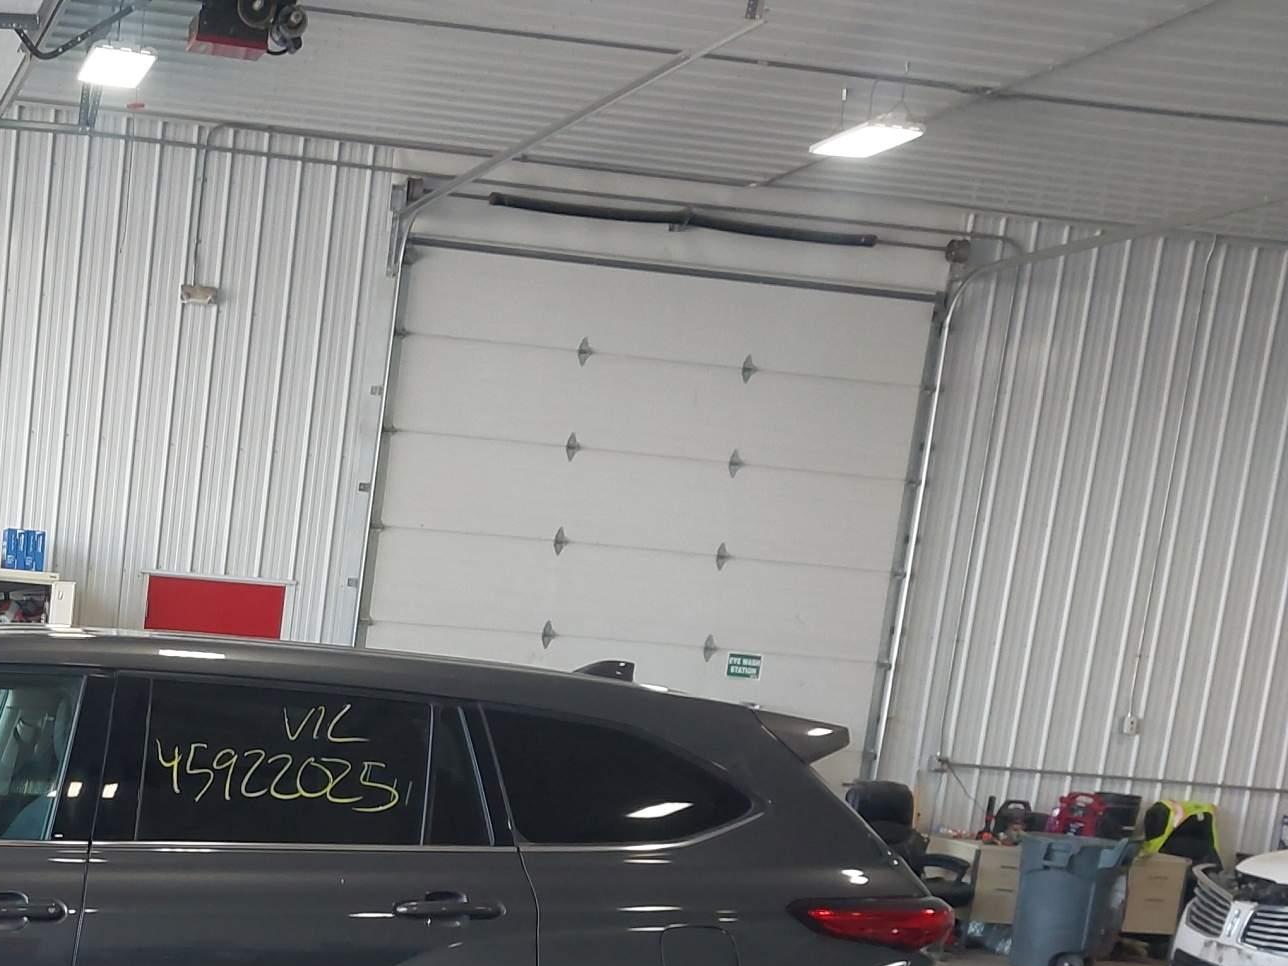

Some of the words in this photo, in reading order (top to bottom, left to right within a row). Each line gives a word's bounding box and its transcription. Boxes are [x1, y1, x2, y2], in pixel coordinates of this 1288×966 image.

[729, 657, 741, 665] EYE
[742, 658, 760, 666] WASH
[730, 665, 757, 674] STATION
[155, 738, 400, 813] 45922025
